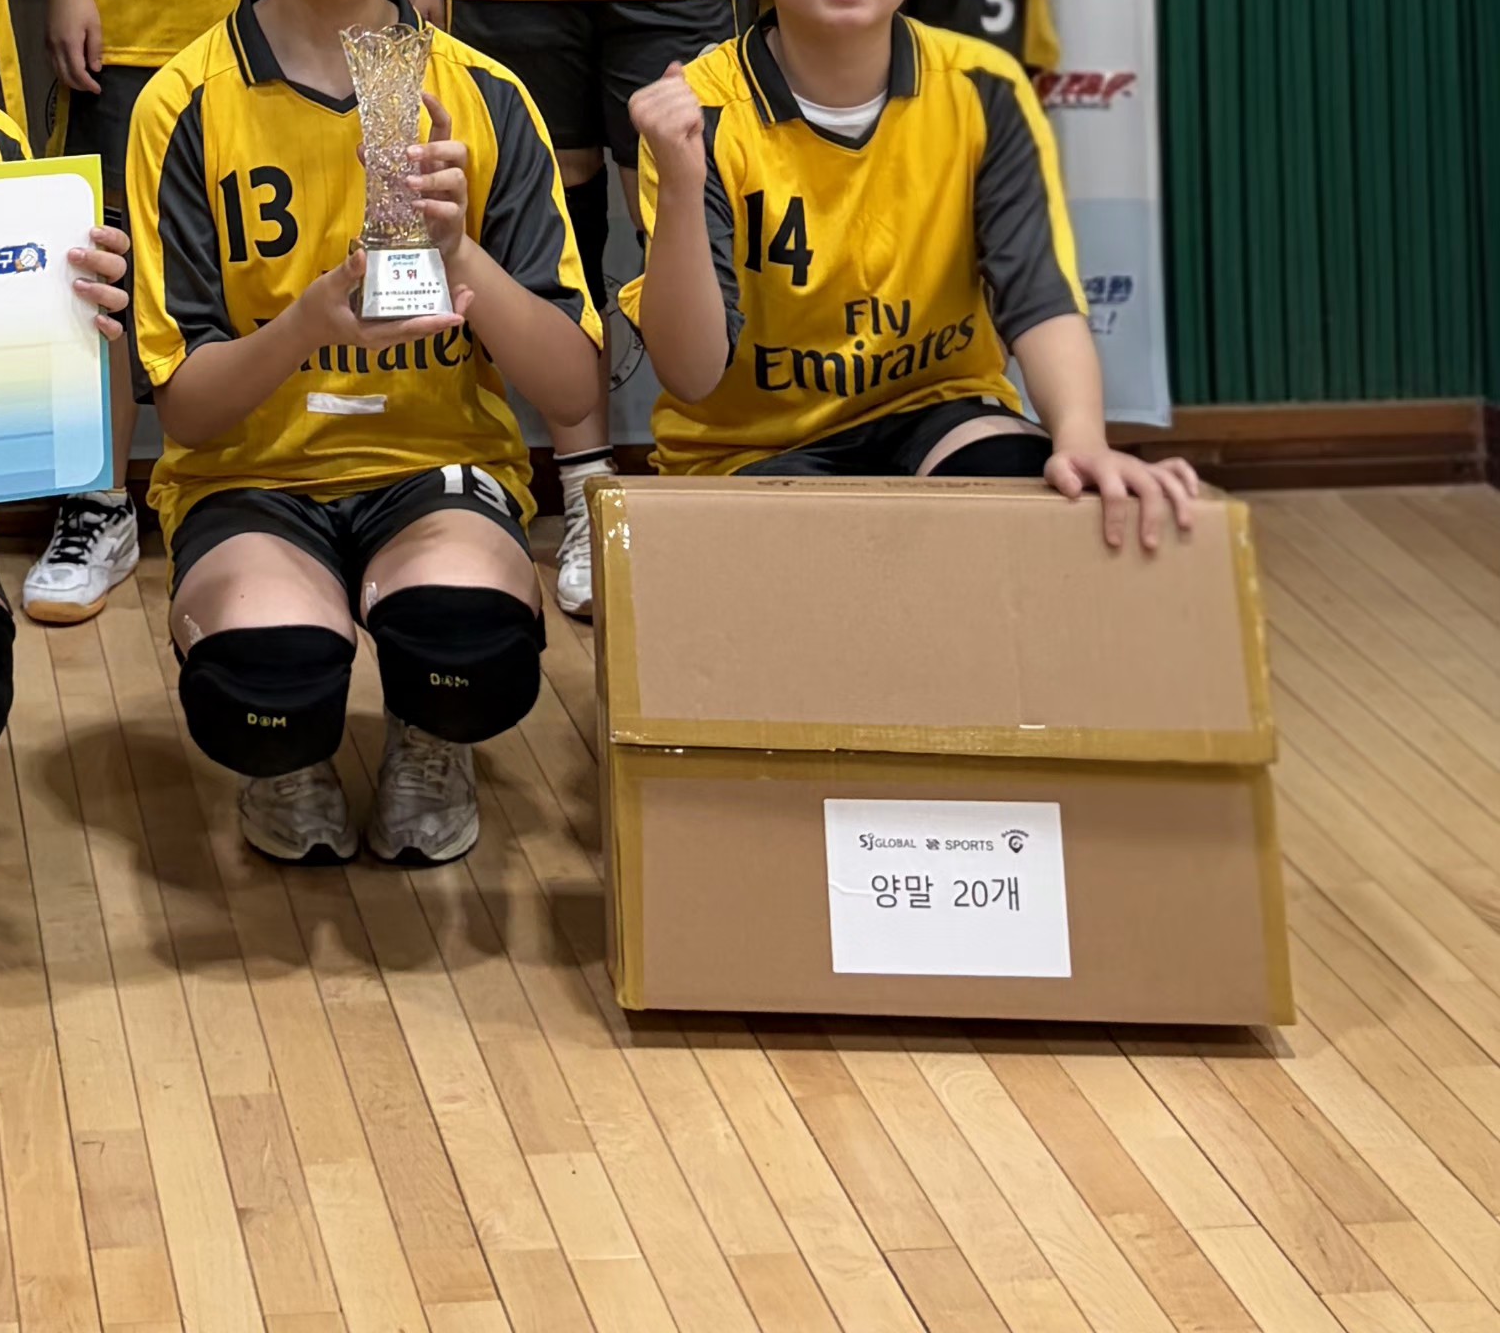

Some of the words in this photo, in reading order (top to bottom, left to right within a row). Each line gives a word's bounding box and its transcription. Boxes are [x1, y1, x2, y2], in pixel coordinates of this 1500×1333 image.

[219, 165, 298, 263] 13
[743, 189, 814, 287] 14
[845, 296, 911, 338] Fly
[753, 313, 976, 398] Emirates
[875, 838, 917, 849] GLOBAL
[945, 839, 995, 851] SPORTS
[871, 875, 934, 909] 양말
[953, 876, 1020, 911] 20개
